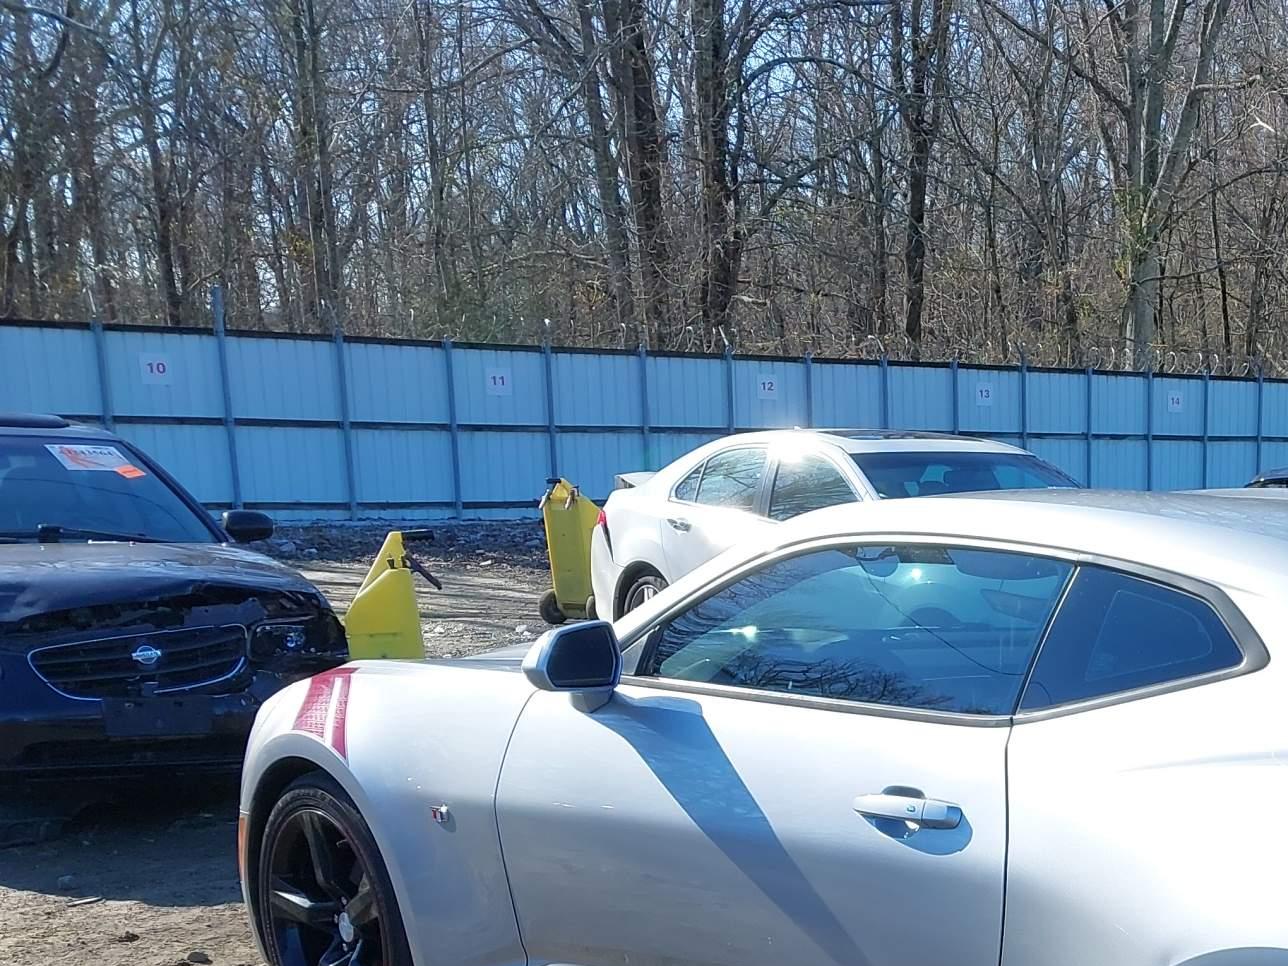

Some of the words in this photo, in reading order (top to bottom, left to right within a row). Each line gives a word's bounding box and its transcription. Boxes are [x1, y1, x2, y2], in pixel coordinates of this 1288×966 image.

[146, 362, 167, 374] 10
[491, 375, 505, 386] 11
[761, 381, 774, 391] 12
[979, 389, 990, 399] 13
[1171, 397, 1180, 405] 14
